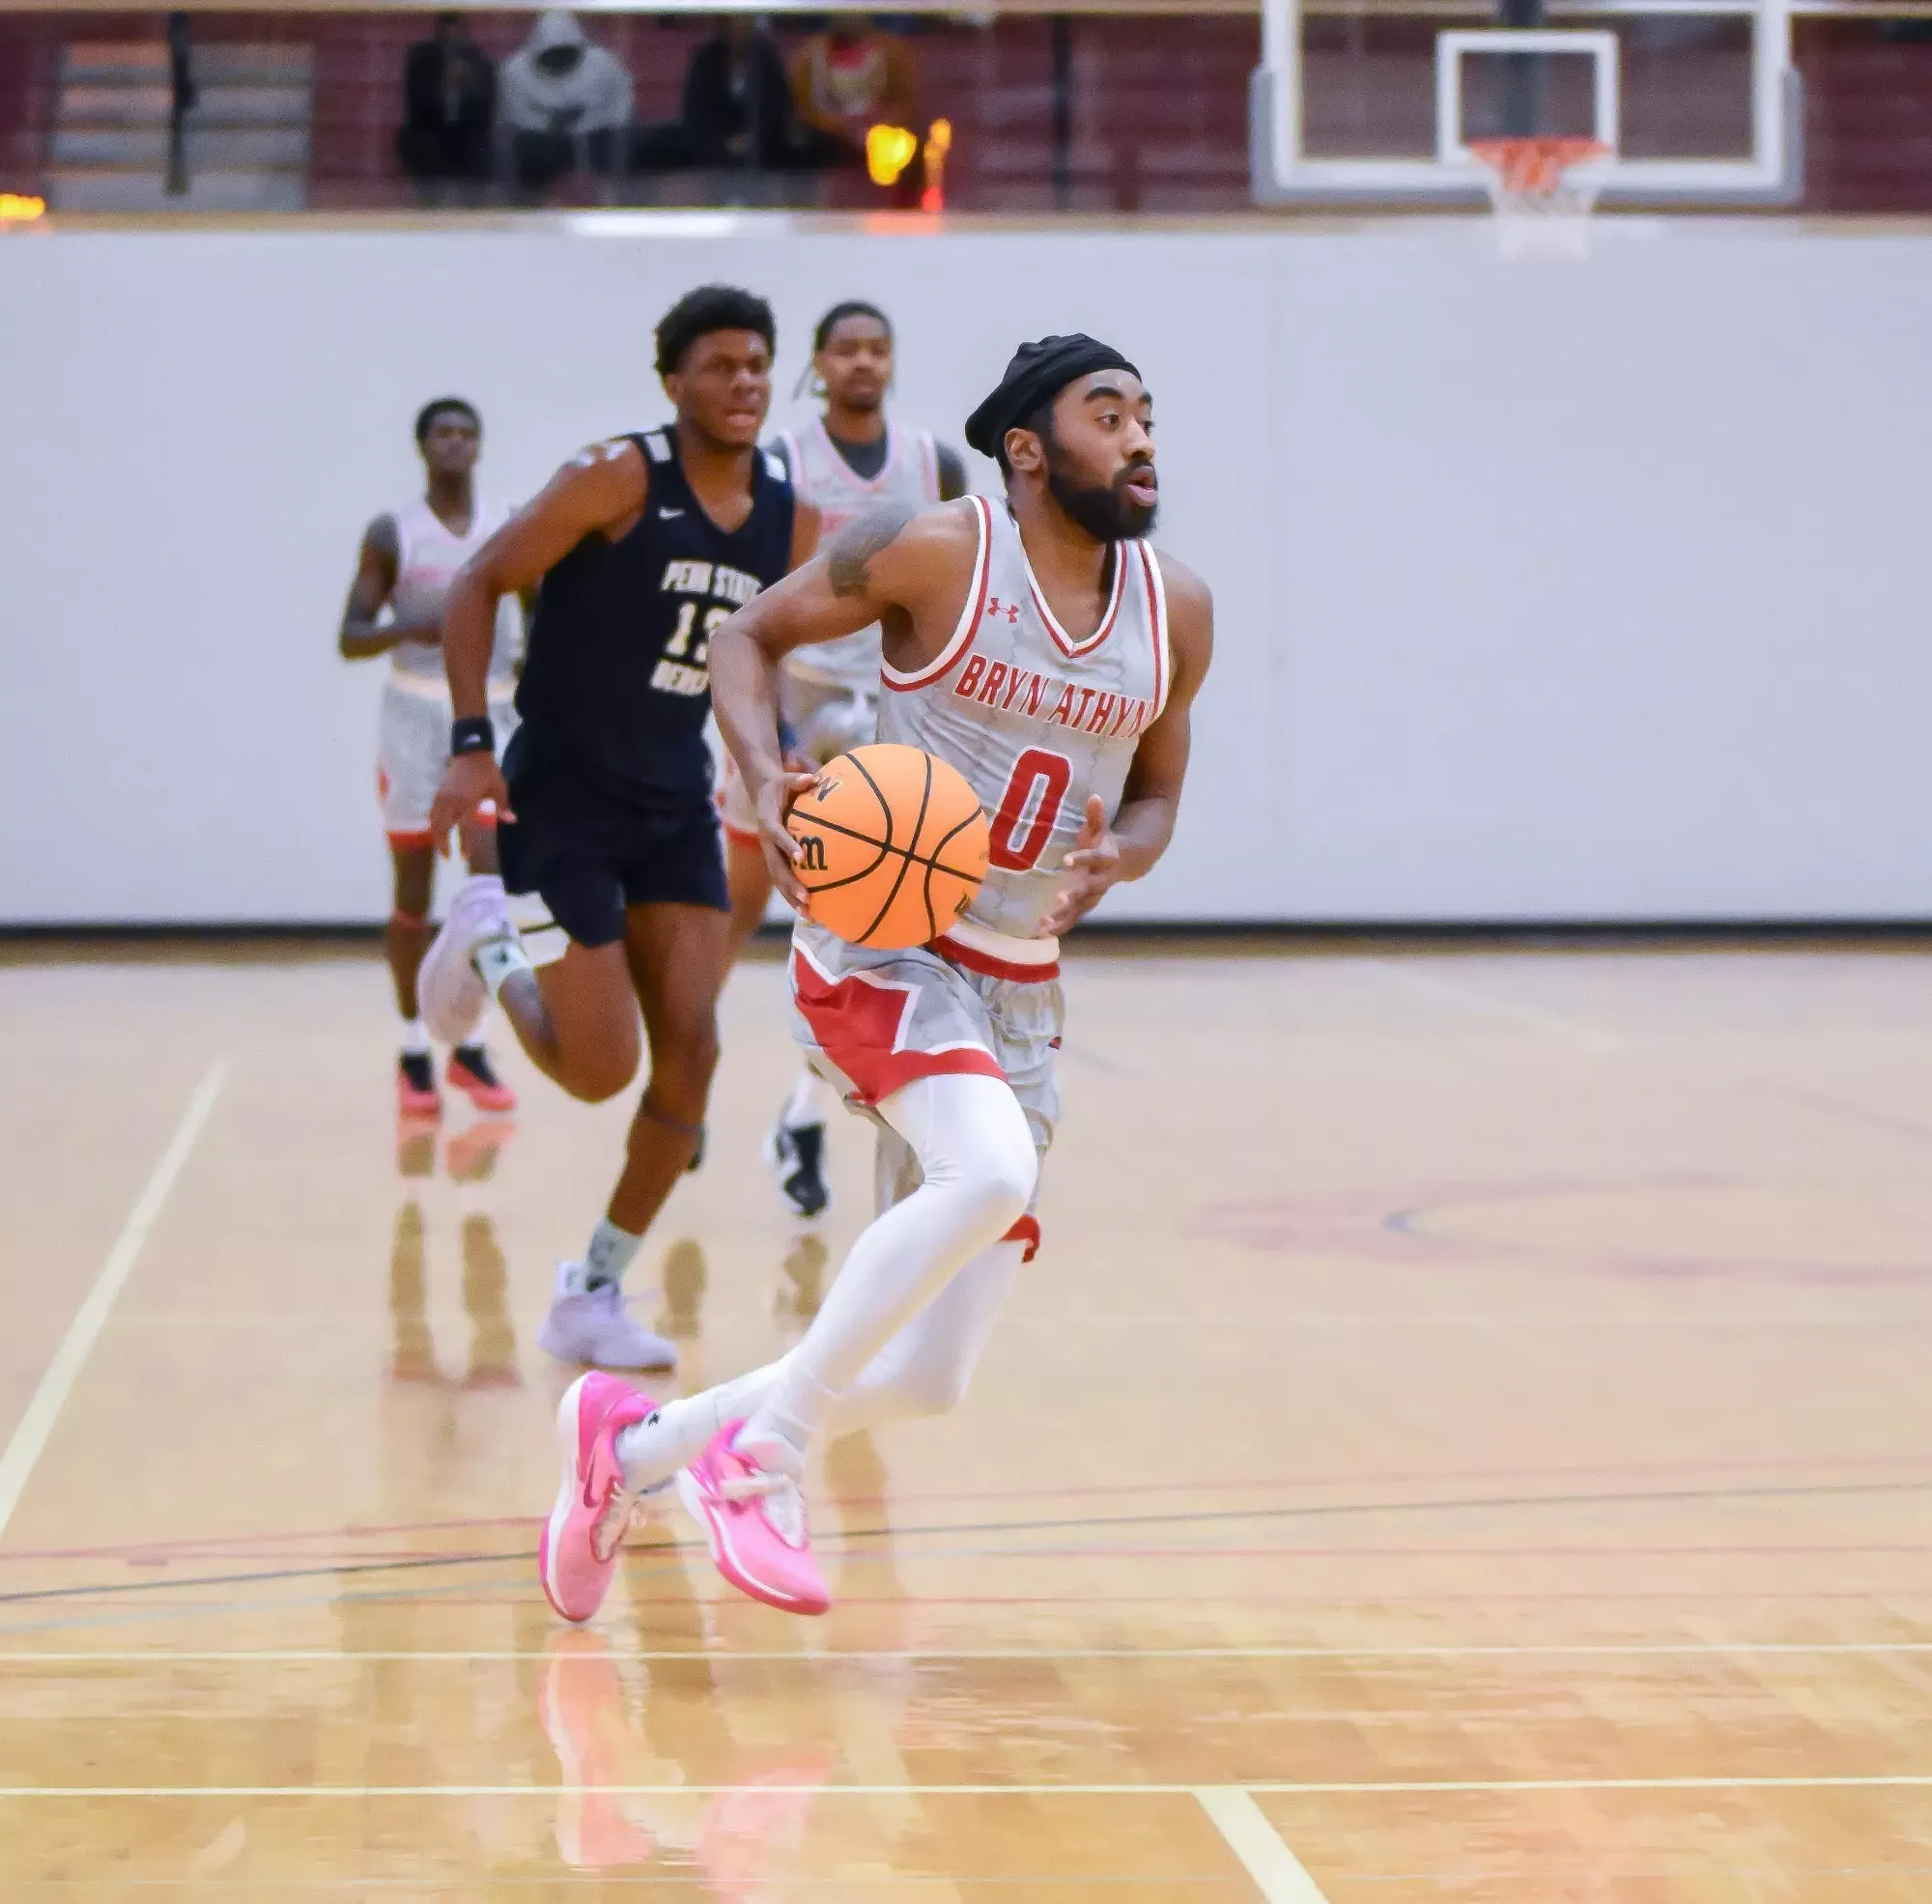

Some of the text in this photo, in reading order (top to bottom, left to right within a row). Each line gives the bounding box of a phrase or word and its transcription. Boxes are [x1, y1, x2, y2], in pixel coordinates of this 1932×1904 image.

[661, 560, 713, 593] PENN
[954, 653, 1154, 739] BRYN ATHYN
[988, 746, 1073, 873] 0
